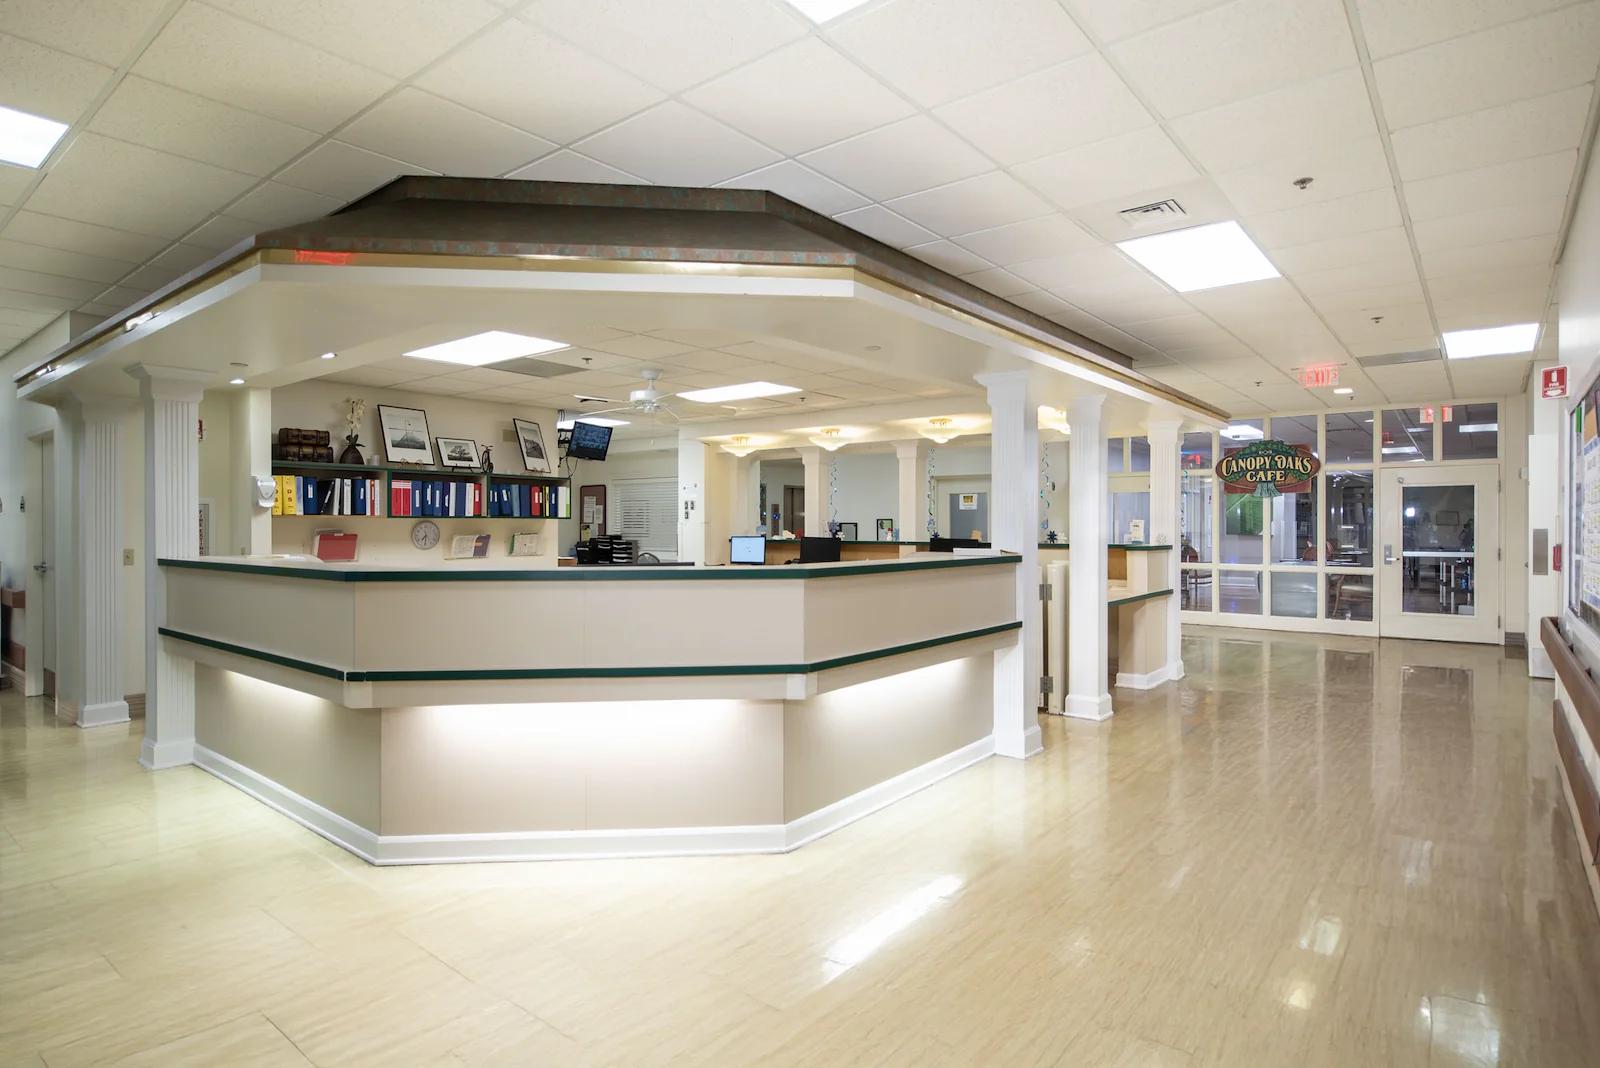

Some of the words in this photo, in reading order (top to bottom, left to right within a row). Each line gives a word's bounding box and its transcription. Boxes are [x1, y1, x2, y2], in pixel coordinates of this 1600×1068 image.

[1306, 367, 1332, 386] EXIT
[1221, 456, 1272, 476] CANOPY
[1274, 455, 1311, 474] OAKS
[1246, 470, 1285, 482] CAFE
